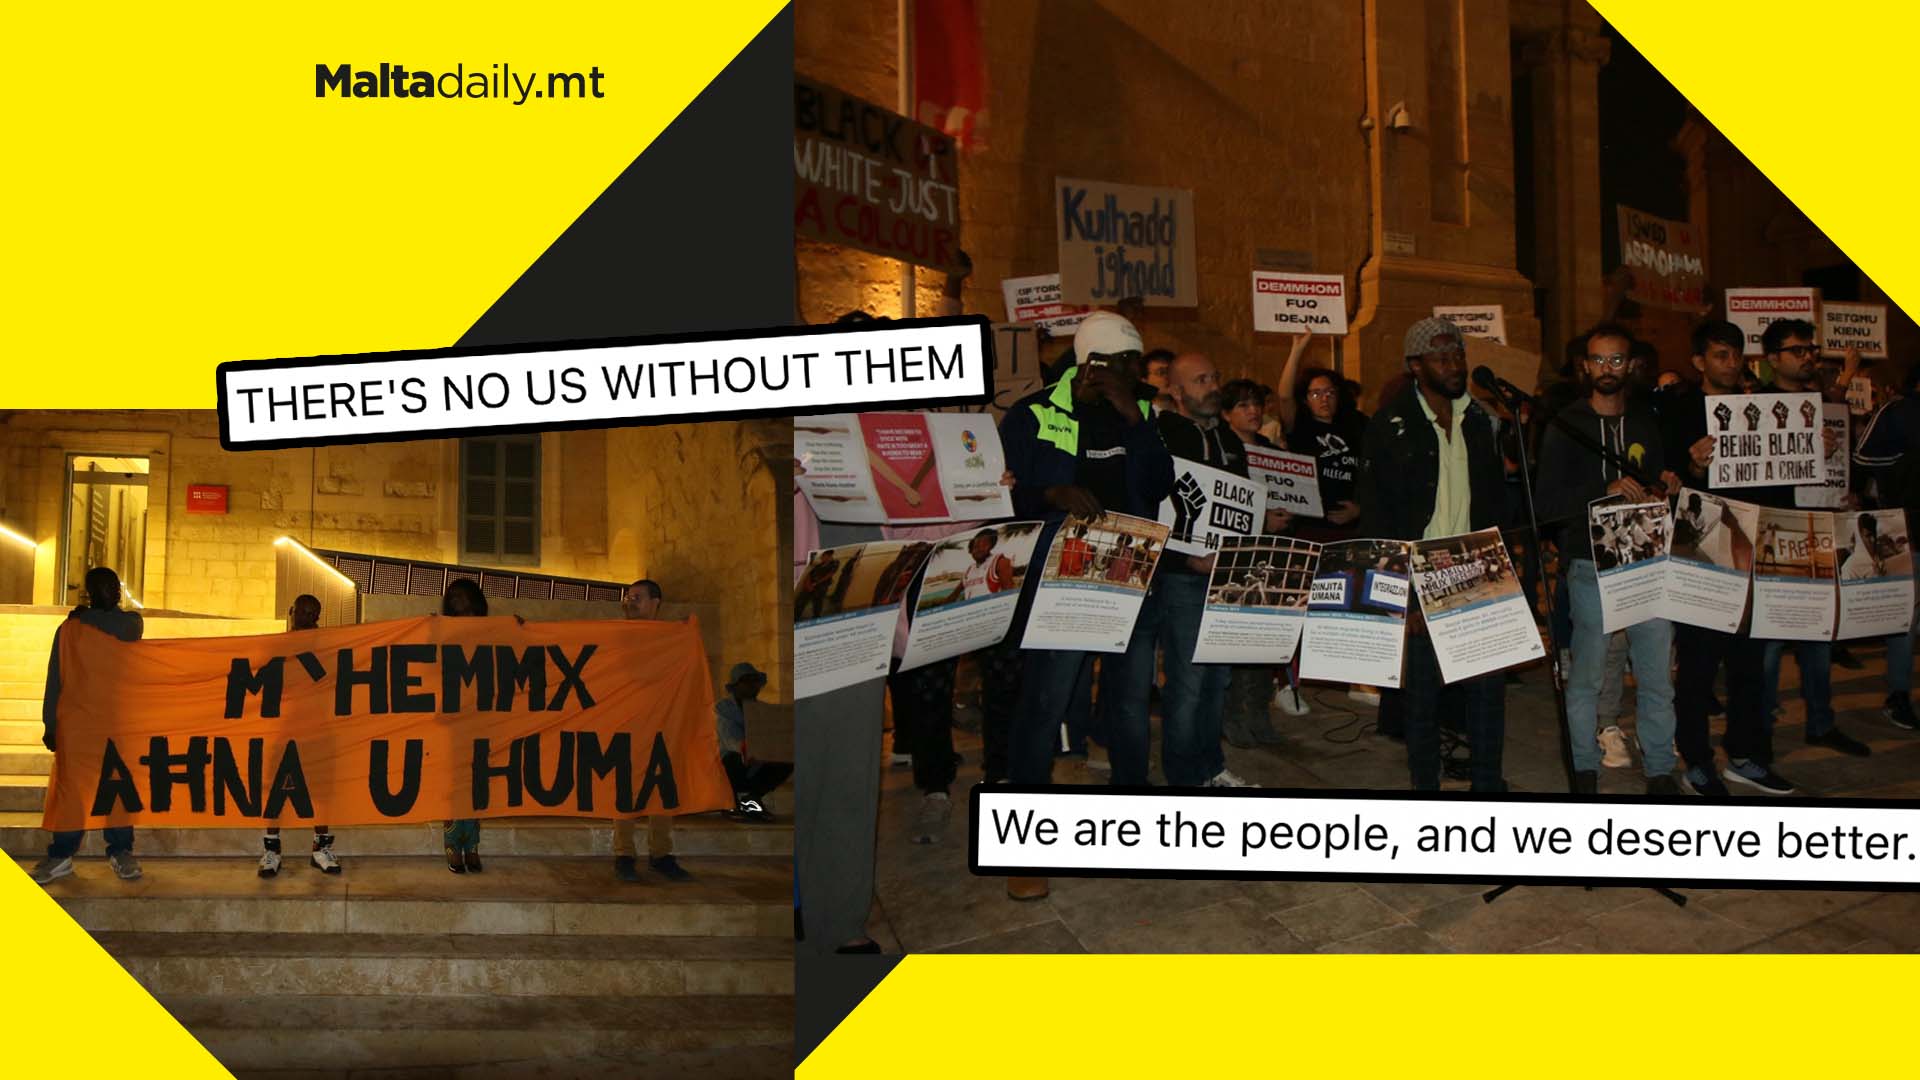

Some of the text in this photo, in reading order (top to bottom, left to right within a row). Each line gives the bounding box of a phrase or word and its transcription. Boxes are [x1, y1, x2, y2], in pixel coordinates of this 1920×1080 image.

[793, 136, 957, 225] WHITE JUST
[795, 186, 953, 266] A COLOUR
[1258, 281, 1341, 295] DEMMHOM
[1286, 299, 1318, 309] FUQ
[1730, 299, 1810, 310] DEMMHOM
[1274, 313, 1331, 325] IDEJNA
[1833, 325, 1872, 336] KIENU
[1823, 418, 1845, 428] ONG
[1720, 434, 1762, 458] BEING
[1769, 432, 1815, 456] BLACK
[1248, 455, 1314, 476] EMMHOM
[1719, 459, 1816, 483] IS NOT A CRIME
[1265, 474, 1295, 488] FUQ
[1823, 479, 1846, 489] ONG
[1213, 479, 1255, 507] BLACK
[1213, 505, 1250, 533] LIVES
[368, 738, 424, 818] U
[472, 730, 681, 815] HUMA
